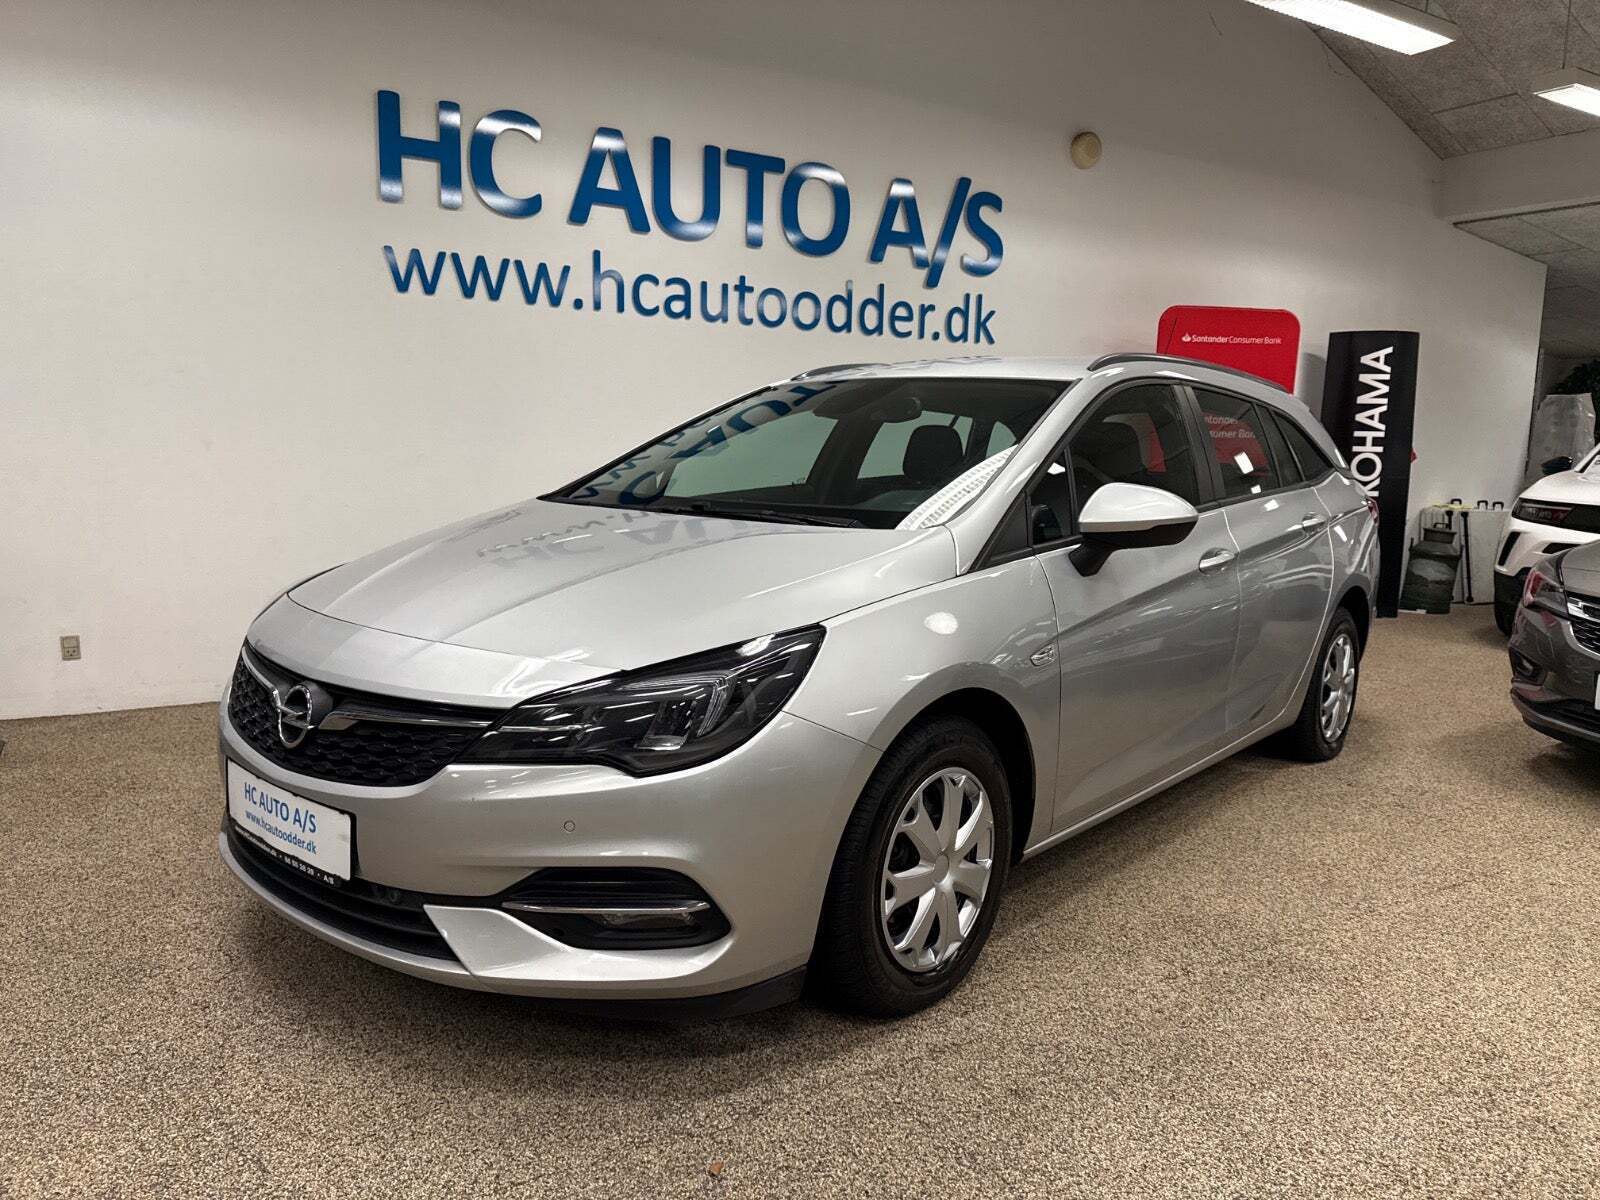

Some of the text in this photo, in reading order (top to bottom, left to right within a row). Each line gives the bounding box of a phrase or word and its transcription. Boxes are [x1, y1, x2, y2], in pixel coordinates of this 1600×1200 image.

[376, 89, 1003, 289] HC AUTO A/S
[382, 245, 996, 345] www.hcautoodder.dk
[1191, 334, 1282, 345] Santander Consumer Bank
[244, 782, 316, 833] HC AUTO A/S
[245, 810, 316, 854] www.hcautoodder.dk
